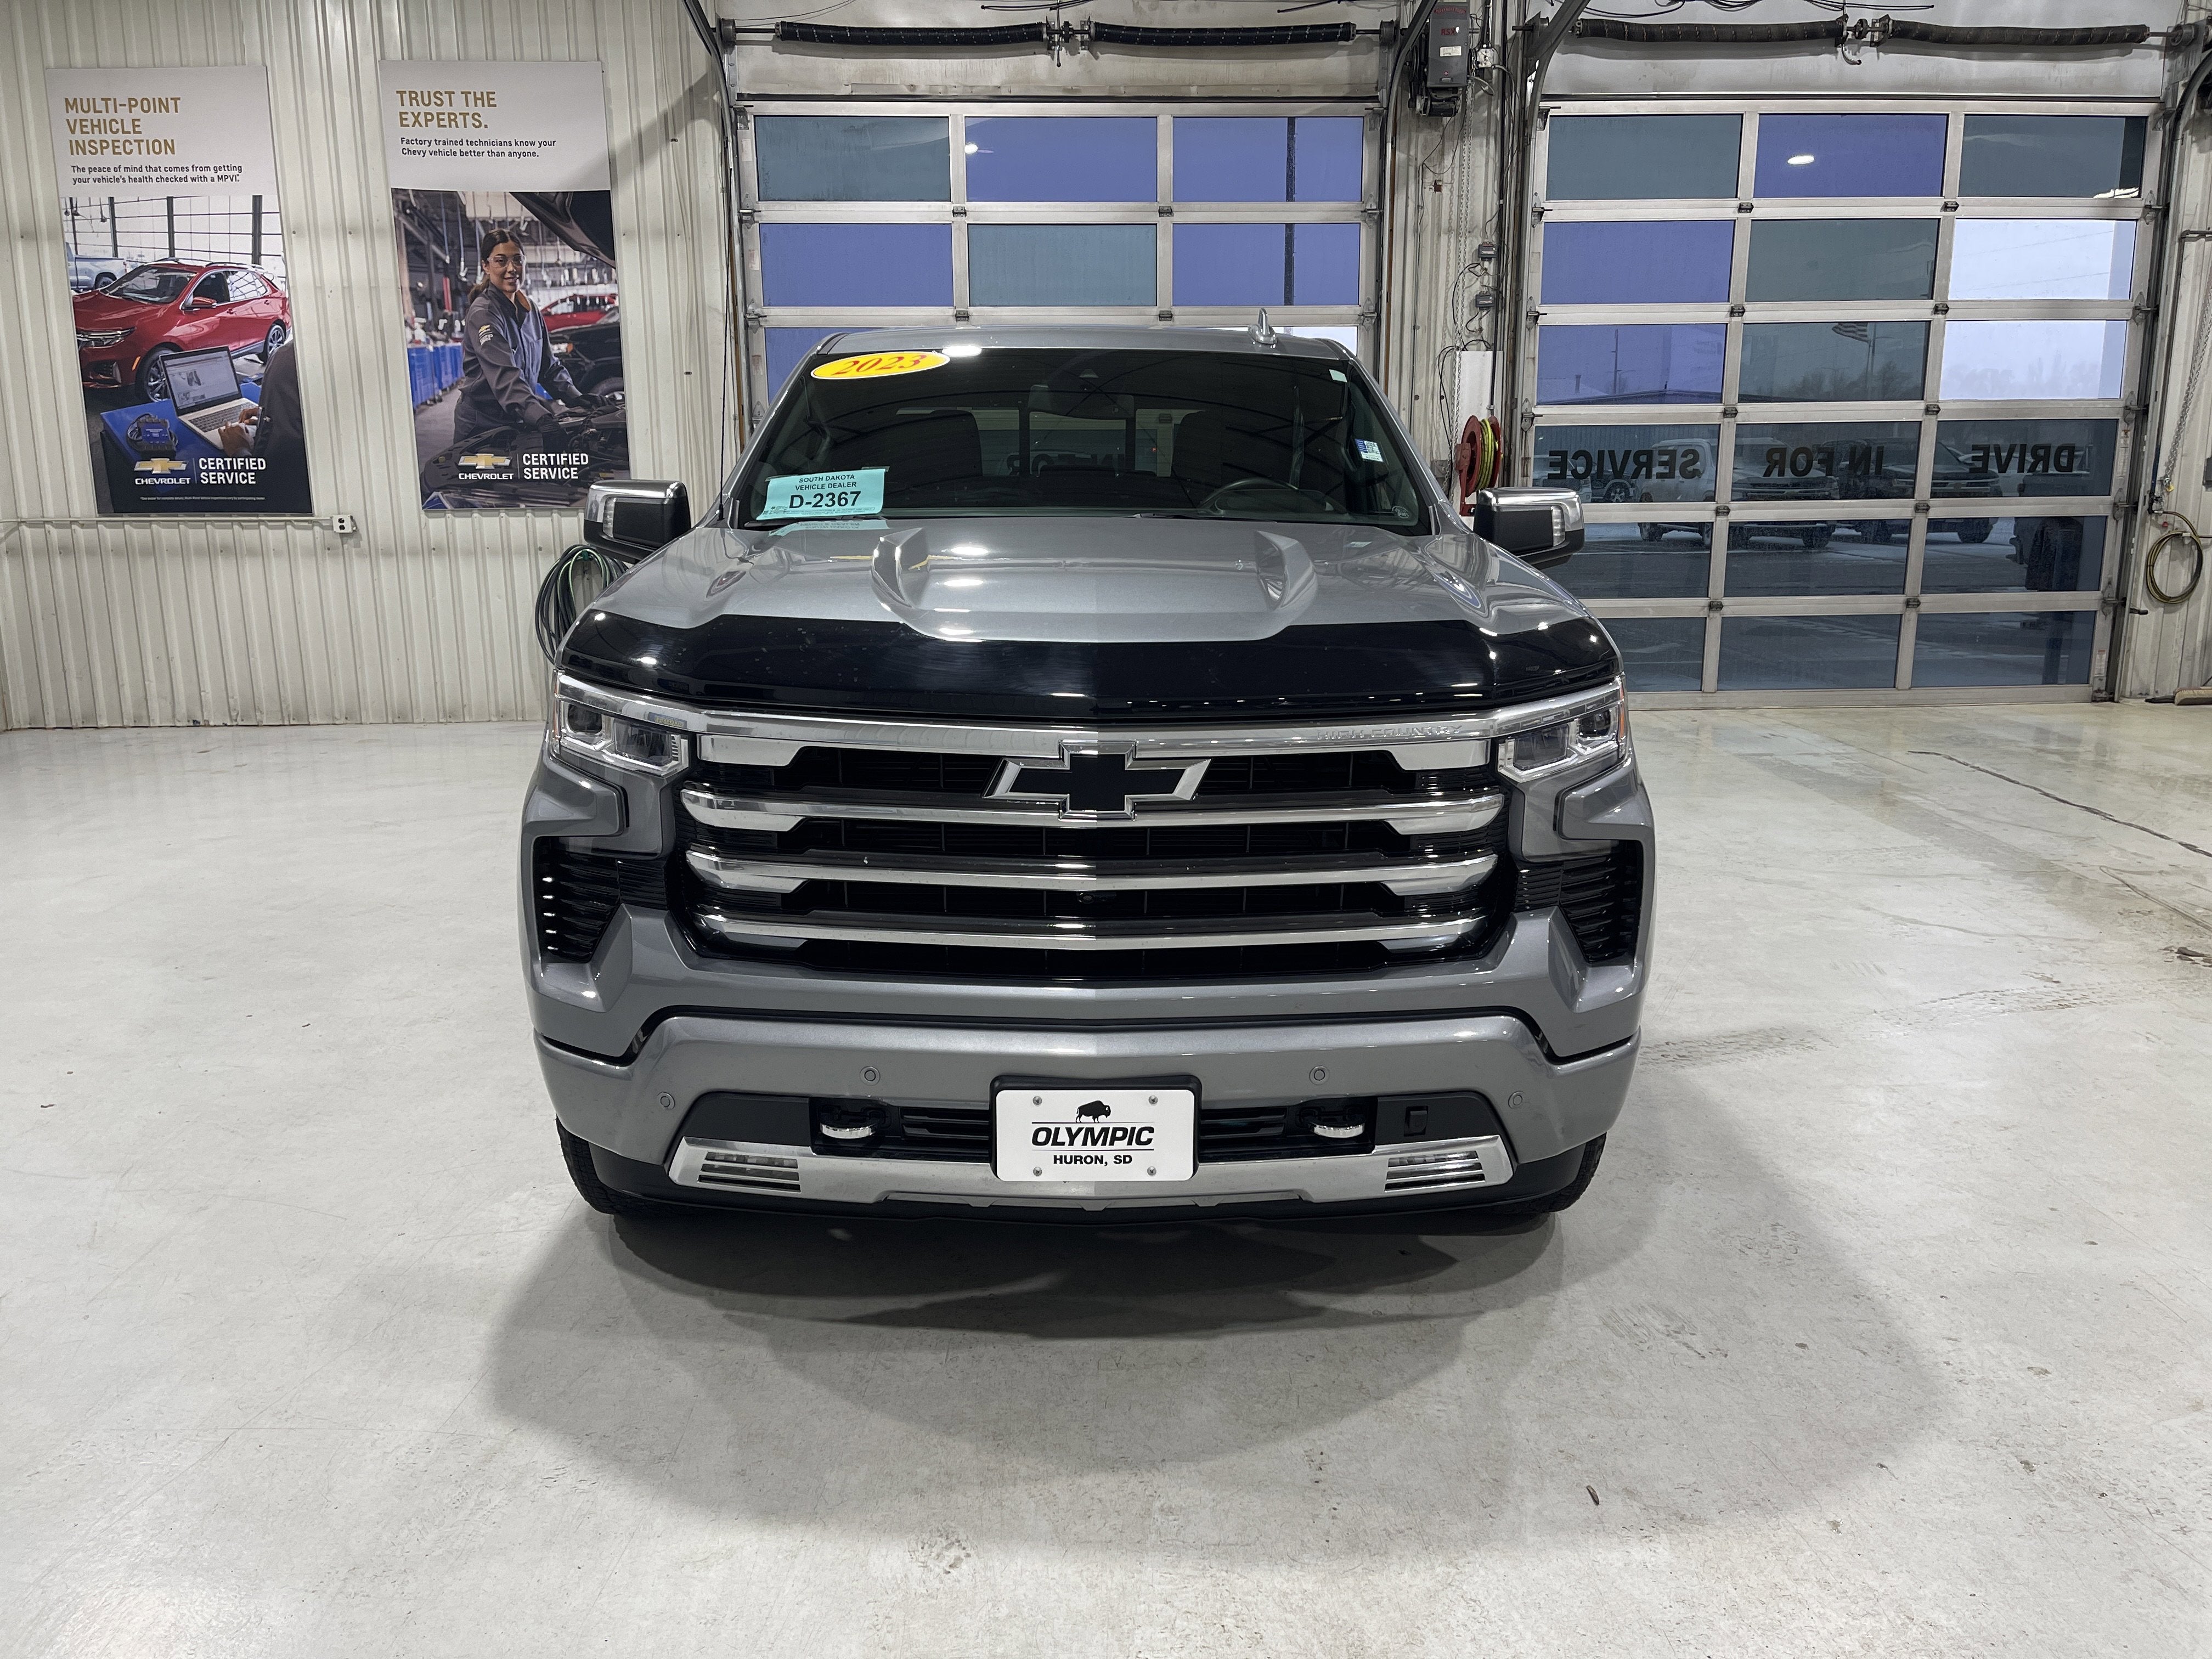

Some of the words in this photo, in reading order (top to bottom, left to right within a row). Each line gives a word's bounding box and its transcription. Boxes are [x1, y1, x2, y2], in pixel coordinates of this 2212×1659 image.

[65, 97, 180, 114] MULTI-POINT
[396, 90, 455, 107] TRUST
[461, 91, 497, 108] THE
[66, 118, 142, 134] VEHICLE
[399, 111, 488, 128] EXPERTS.
[69, 139, 176, 156] INSPECTION
[400, 137, 432, 147] Factory
[435, 138, 464, 146] trained
[466, 138, 512, 147] technicians
[514, 139, 536, 147] know
[538, 140, 556, 148] your
[402, 148, 427, 157] Chevy
[429, 149, 457, 157] vehicle
[459, 149, 485, 157] better
[487, 149, 505, 157] than
[507, 150, 539, 159] anyone.
[71, 165, 86, 173] The
[88, 166, 111, 174] peace
[123, 165, 143, 173] mind
[145, 165, 162, 173] that
[191, 164, 211, 172] from
[213, 164, 242, 173] getting
[72, 177, 90, 185] your
[92, 175, 126, 183] vehicle's
[128, 175, 153, 183] health
[155, 174, 188, 183] checked
[831, 355, 927, 375] 2023
[199, 457, 266, 470] CERTIFIED
[523, 453, 588, 465] CERTIFIED
[200, 472, 256, 484] SERVICE
[524, 467, 578, 479] SERVICE
[789, 491, 861, 509] D-2367
[1032, 1126, 1154, 1146] OLYMPIC
[1053, 1155, 1108, 1166] HURON,
[1114, 1155, 1132, 1164] SD
